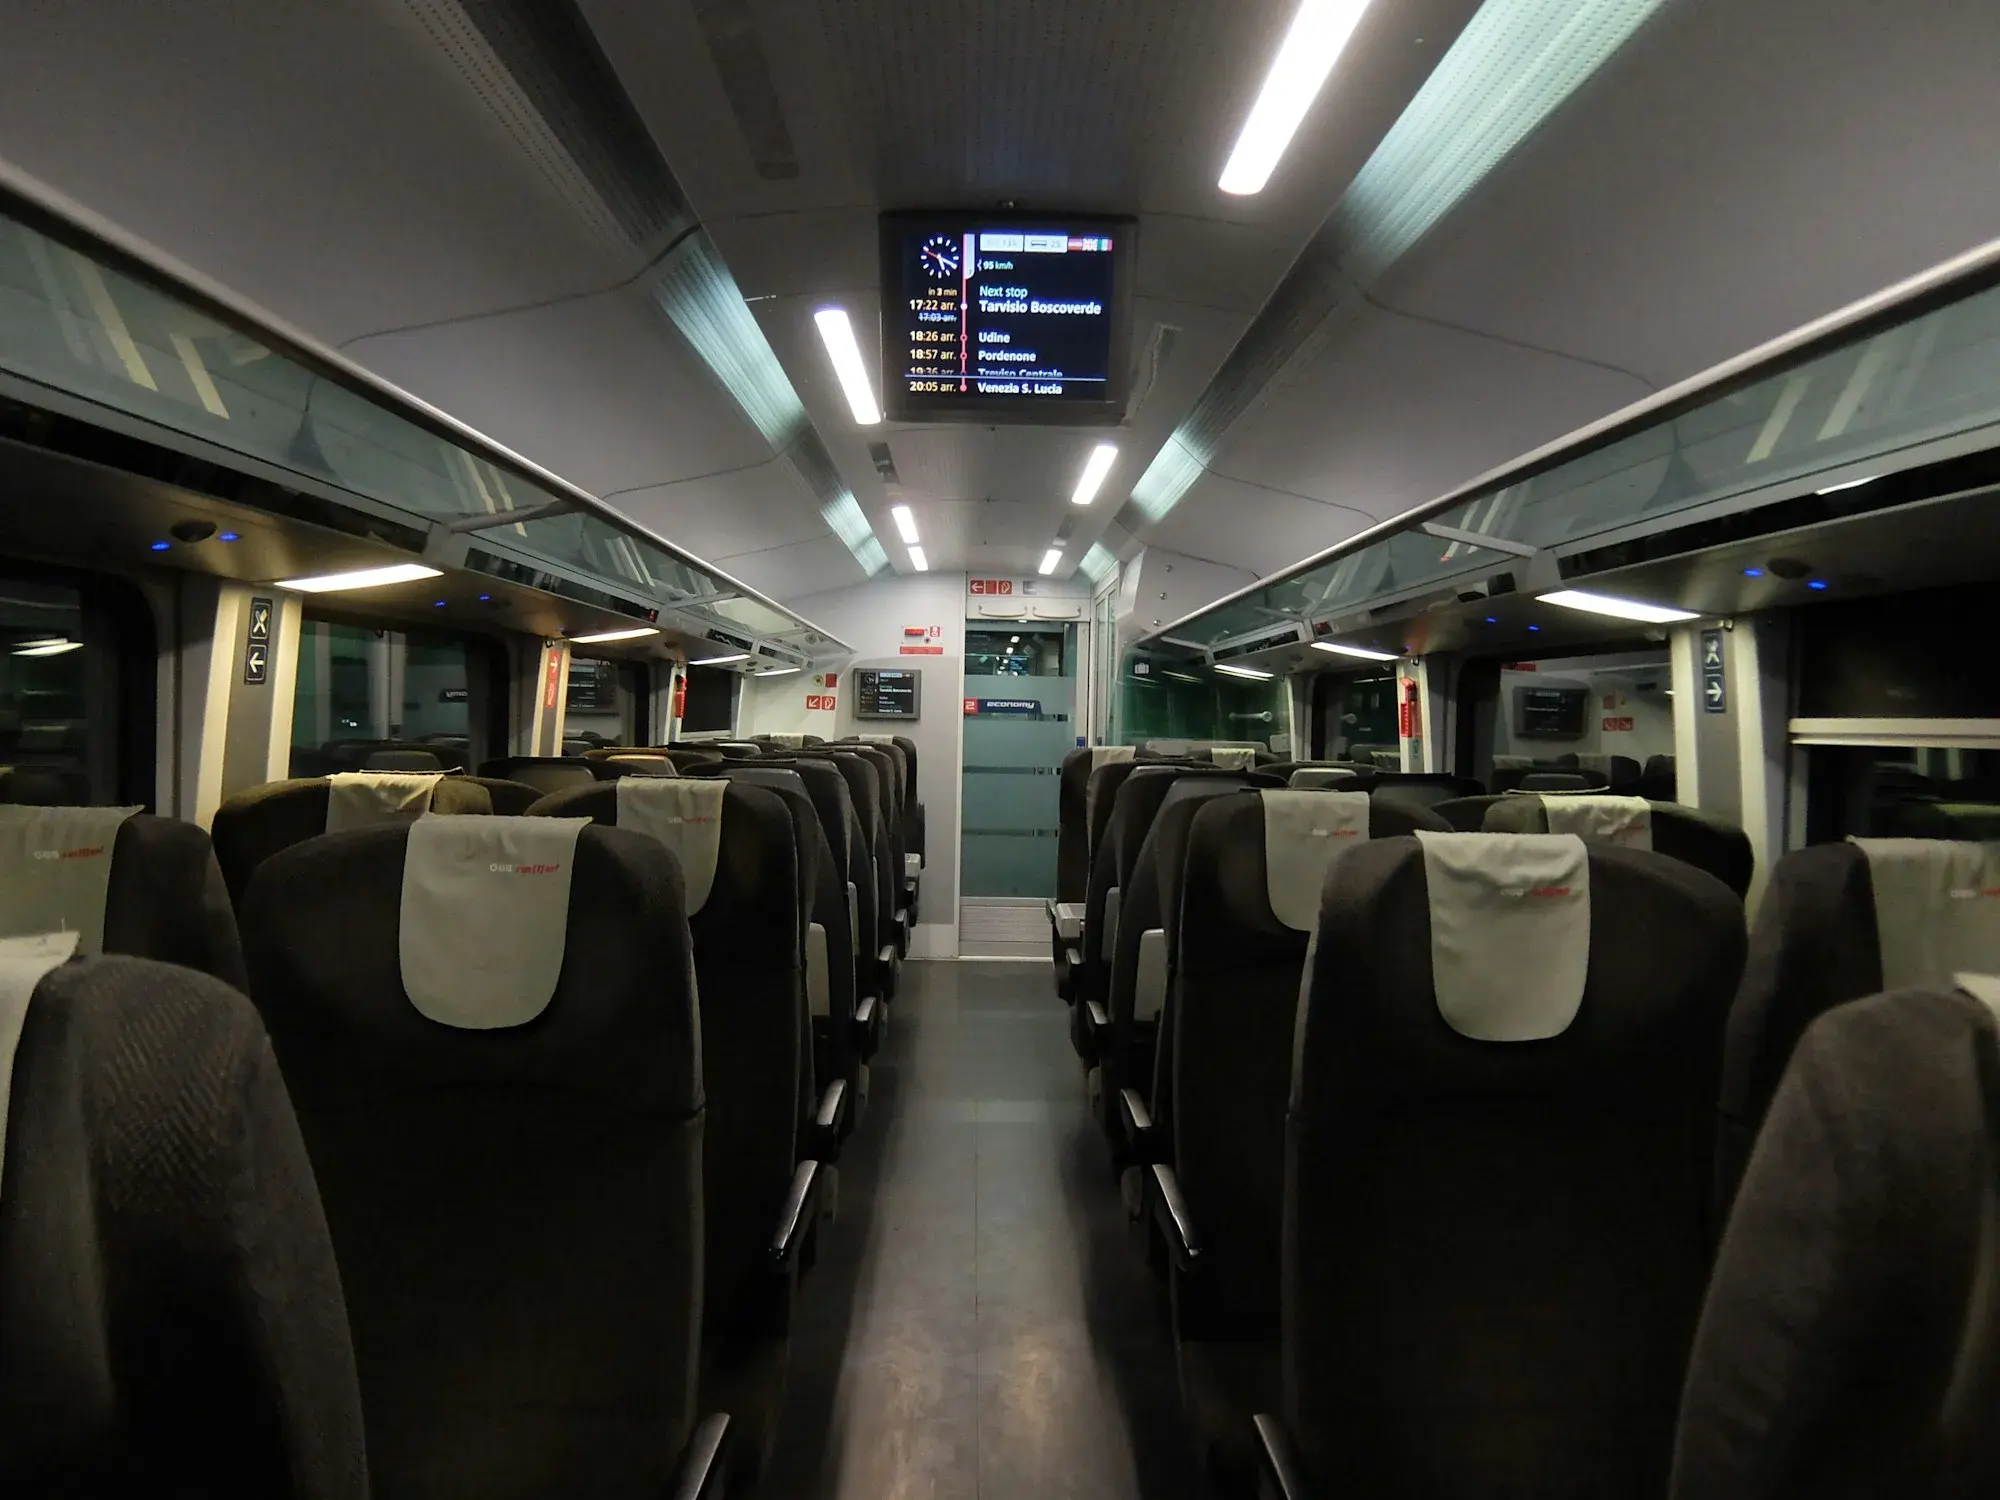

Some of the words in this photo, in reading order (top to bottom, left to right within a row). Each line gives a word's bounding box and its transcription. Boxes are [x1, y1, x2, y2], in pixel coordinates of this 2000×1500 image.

[983, 260, 994, 270] 95
[995, 261, 1014, 270] km/h
[928, 287, 936, 296] in
[936, 287, 943, 297] 3
[943, 287, 958, 296] min
[979, 285, 1004, 297] Next
[1005, 286, 1028, 299] stop
[909, 299, 938, 311] 17:22
[940, 301, 957, 311] arr.
[979, 299, 1028, 313] Tarvisio
[1030, 301, 1101, 315] Boscoverde
[909, 331, 939, 342] 18:26
[940, 333, 957, 342] arr.
[978, 331, 1011, 344] Udine
[909, 348, 938, 360] 18:57
[940, 351, 957, 360] arr.
[978, 350, 1037, 362] Pordenone
[909, 381, 938, 392] 20:05
[940, 383, 957, 392] arr.
[977, 382, 1020, 394] Venezia
[1021, 383, 1032, 394] S.
[1034, 383, 1062, 395] Lucia
[965, 701, 975, 710] 2
[986, 701, 1035, 709] economy
